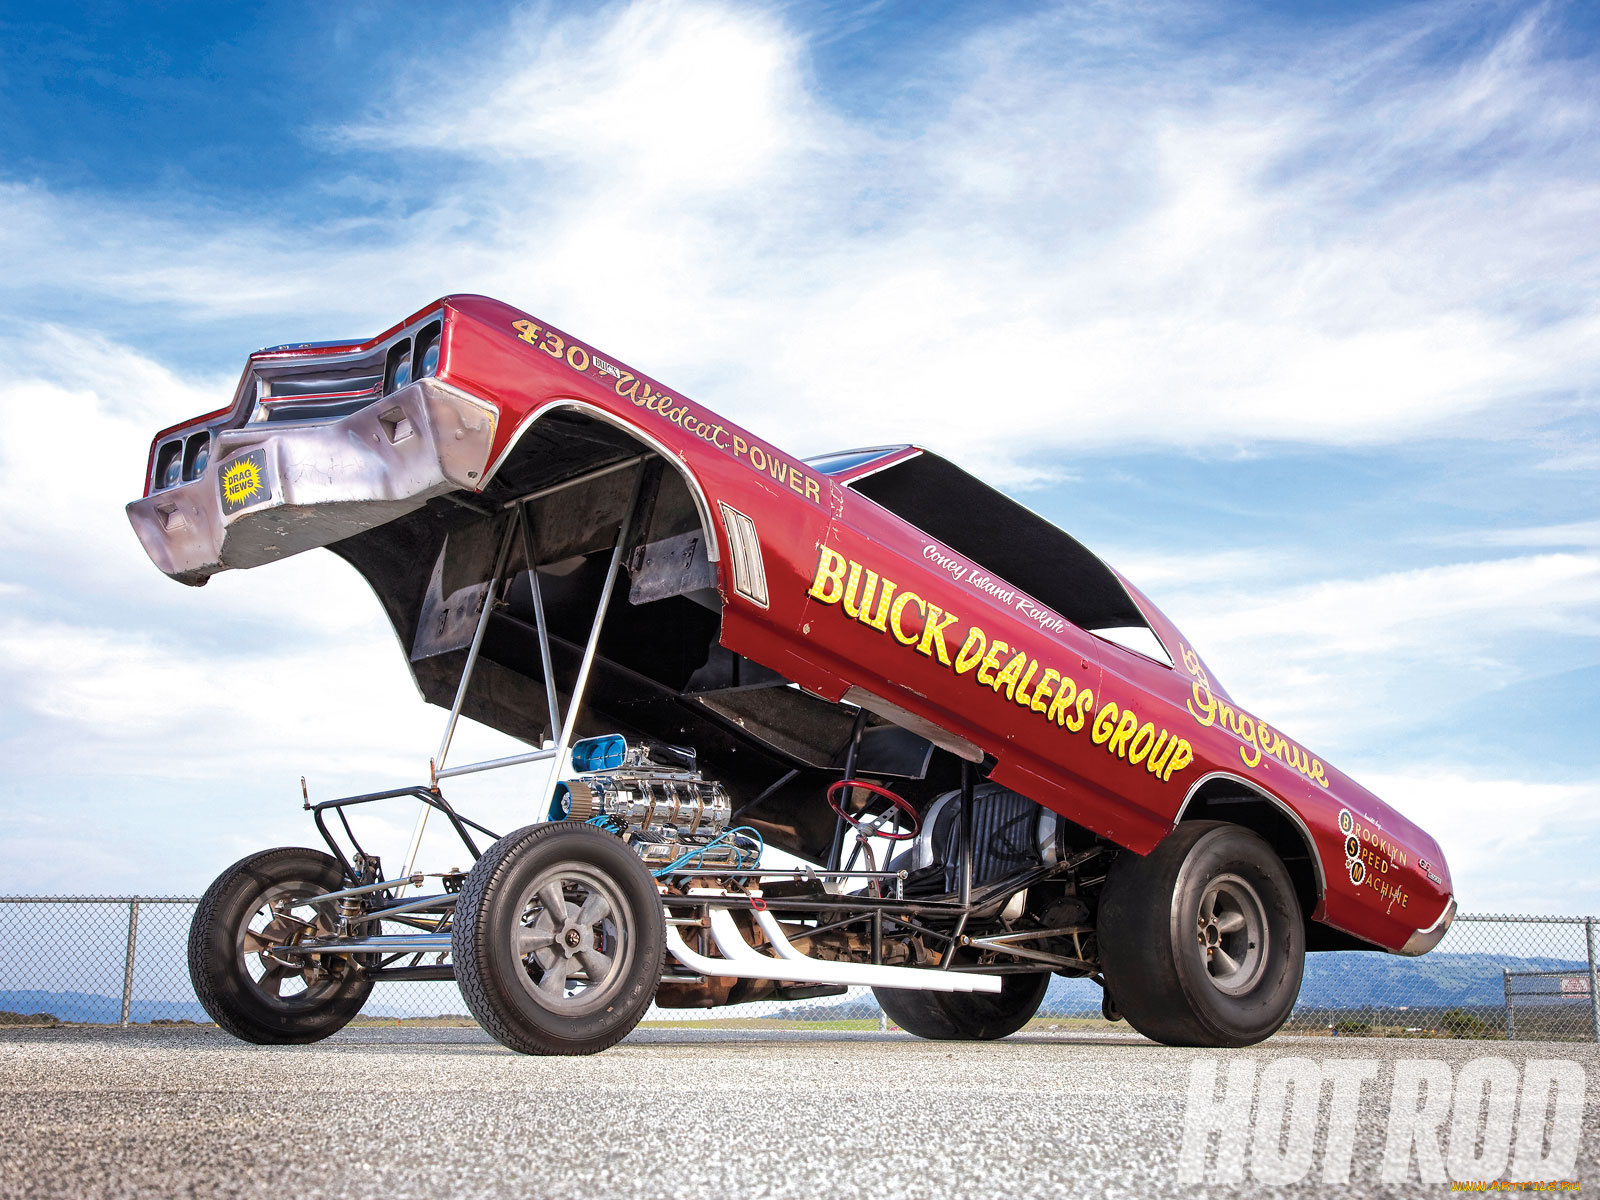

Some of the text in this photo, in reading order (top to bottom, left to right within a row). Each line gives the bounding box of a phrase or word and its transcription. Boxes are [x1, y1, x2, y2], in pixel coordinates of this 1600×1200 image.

[511, 318, 821, 505] 430 Wildcat POWER
[228, 469, 252, 485] DRAG
[229, 479, 254, 495] NEWS
[965, 569, 1014, 605] Island
[807, 544, 1193, 782] BUICK DEALERS GROUP
[1342, 814, 1407, 866] BROOKLYN
[1349, 840, 1388, 873] SPEED
[1352, 864, 1408, 908] MACHINE
